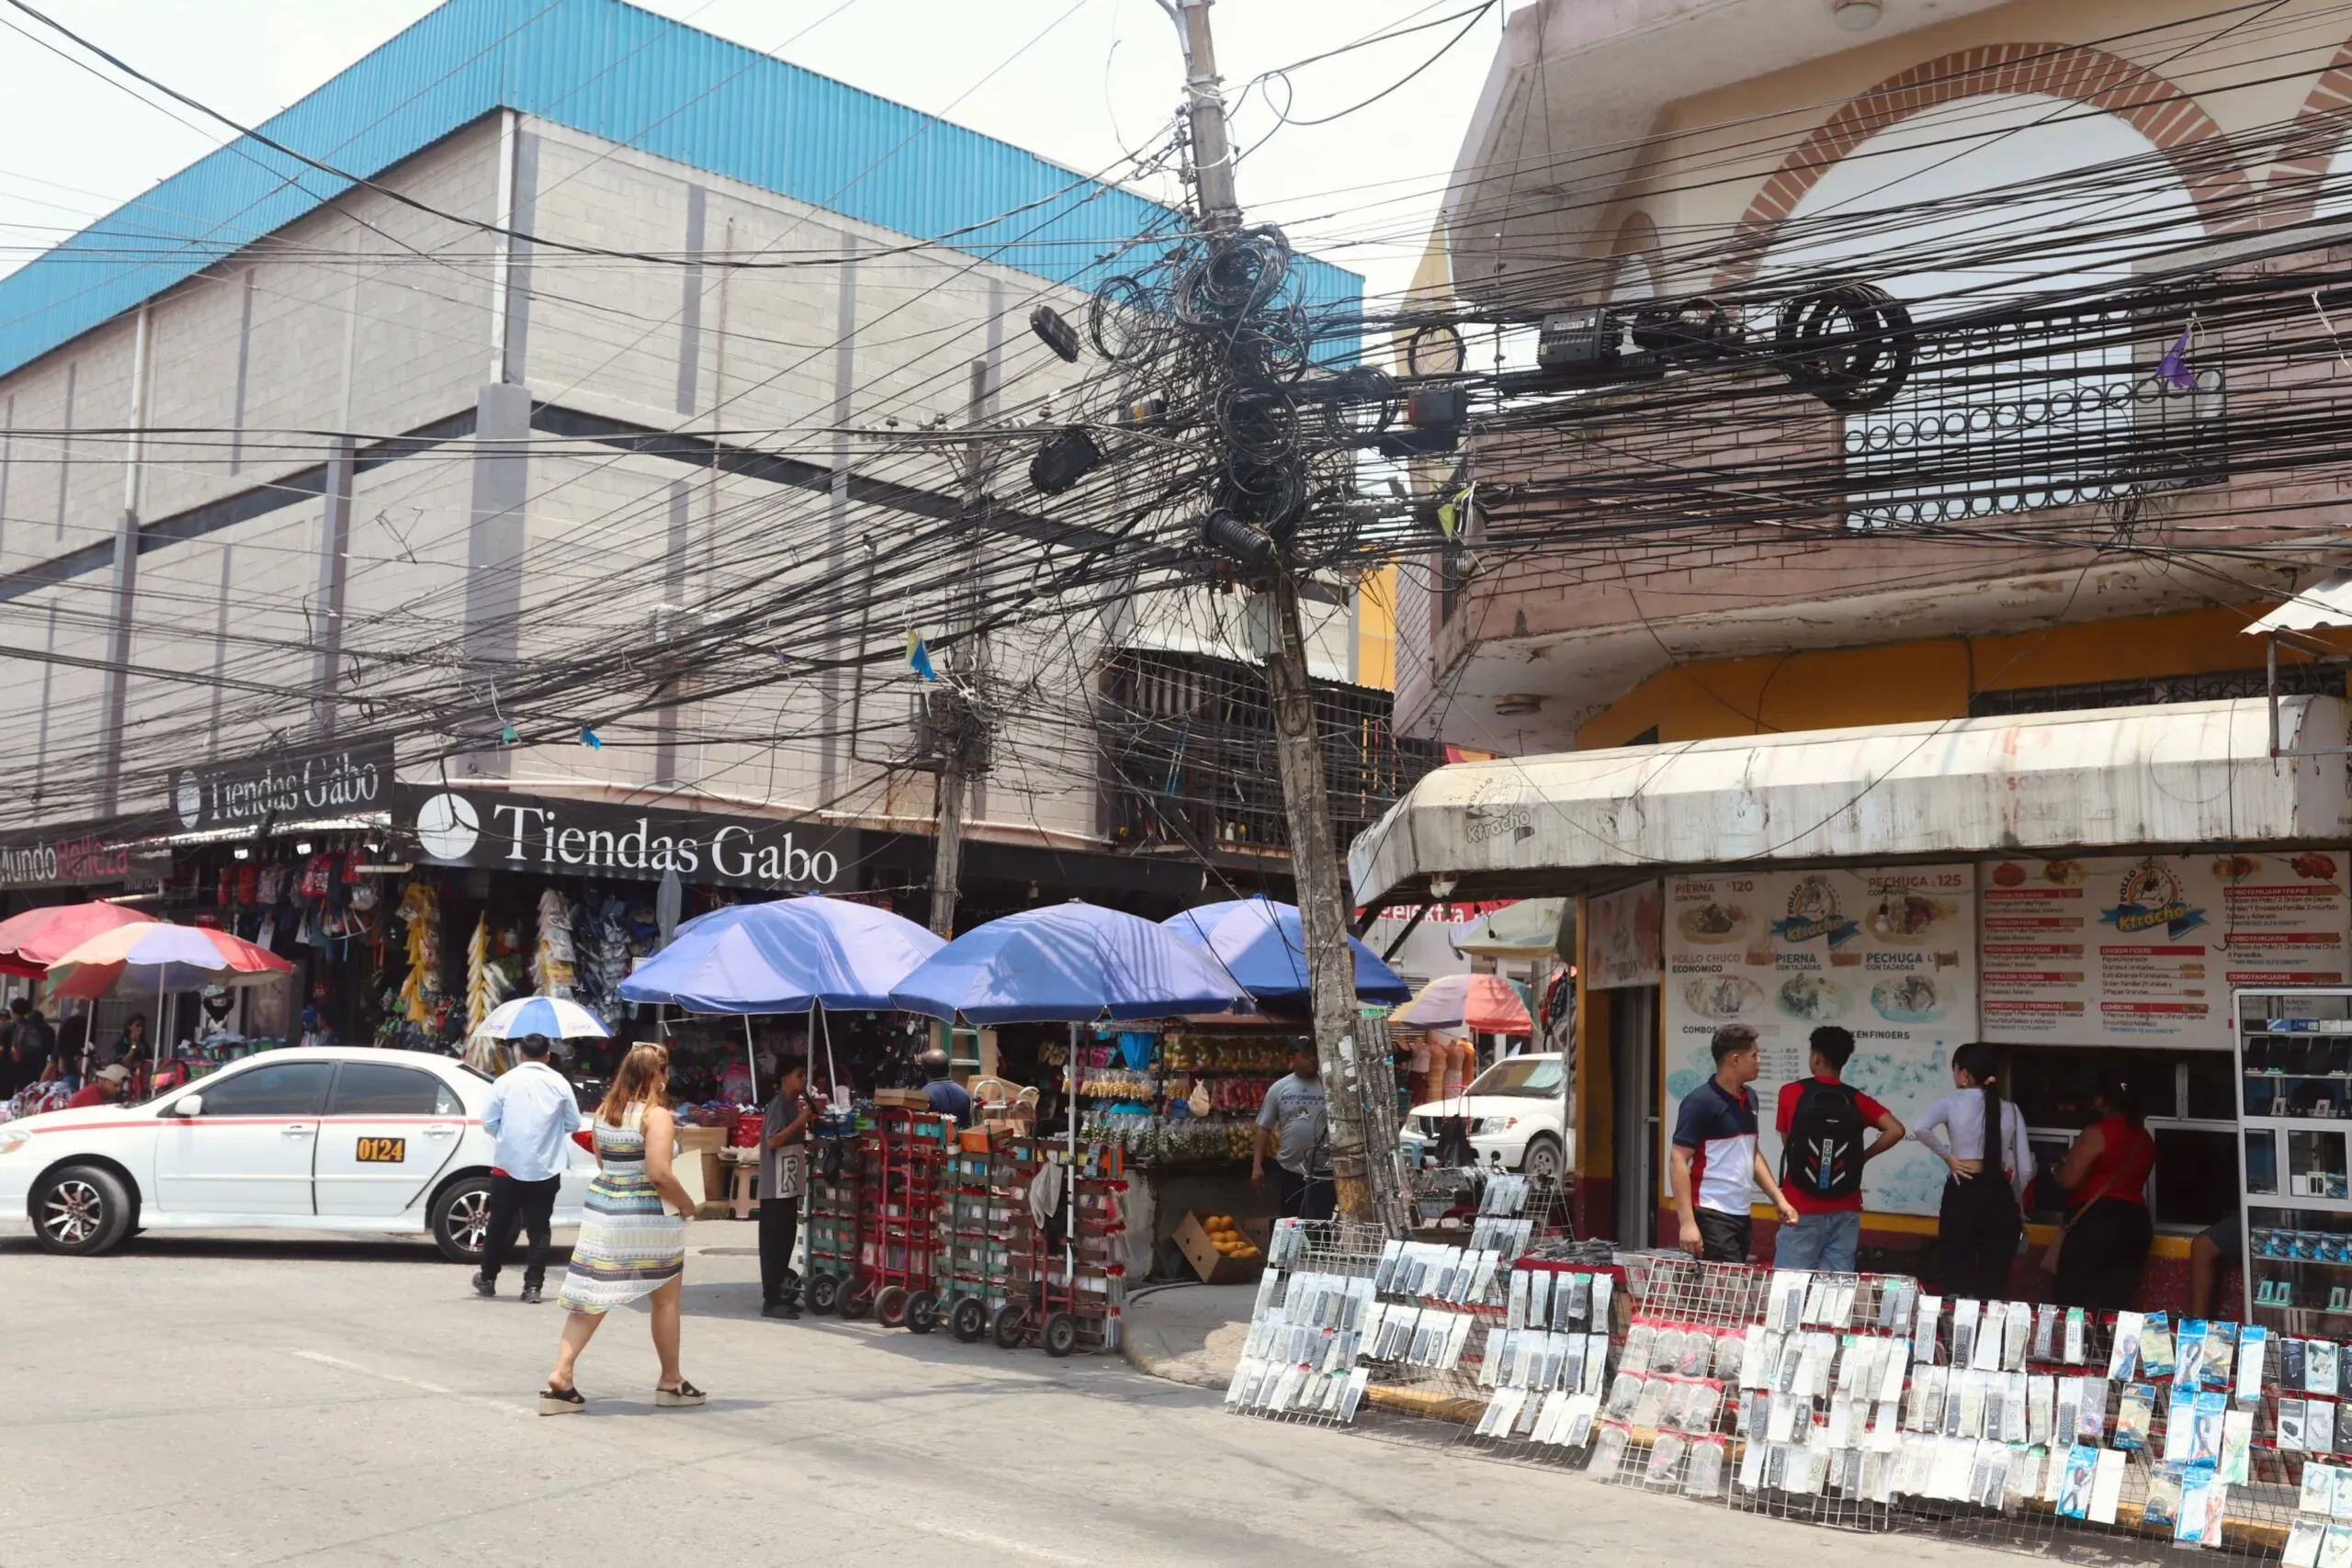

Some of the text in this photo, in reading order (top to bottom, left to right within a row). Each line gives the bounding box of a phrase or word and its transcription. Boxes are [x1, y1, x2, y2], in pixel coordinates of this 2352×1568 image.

[303, 752, 379, 808] Gabo
[493, 804, 839, 885] Tiendas Gabo
[1868, 876, 1928, 887] PECHUGA
[1937, 874, 1962, 886] 125
[2120, 869, 2136, 903] POLLO
[1675, 883, 1715, 895] PIERNA
[1732, 881, 1754, 893] 120
[1787, 884, 1803, 916] POLLO
[1672, 953, 1742, 964] POLLO CHUCO
[1775, 953, 1817, 964] PIERNA
[1866, 953, 1923, 964] PECHUGA
[1672, 964, 1723, 974] ECONOMICO
[1682, 1026, 1717, 1034] COMBOS
[1870, 1031, 1910, 1040] FINGERS
[358, 1138, 403, 1161] 0124
